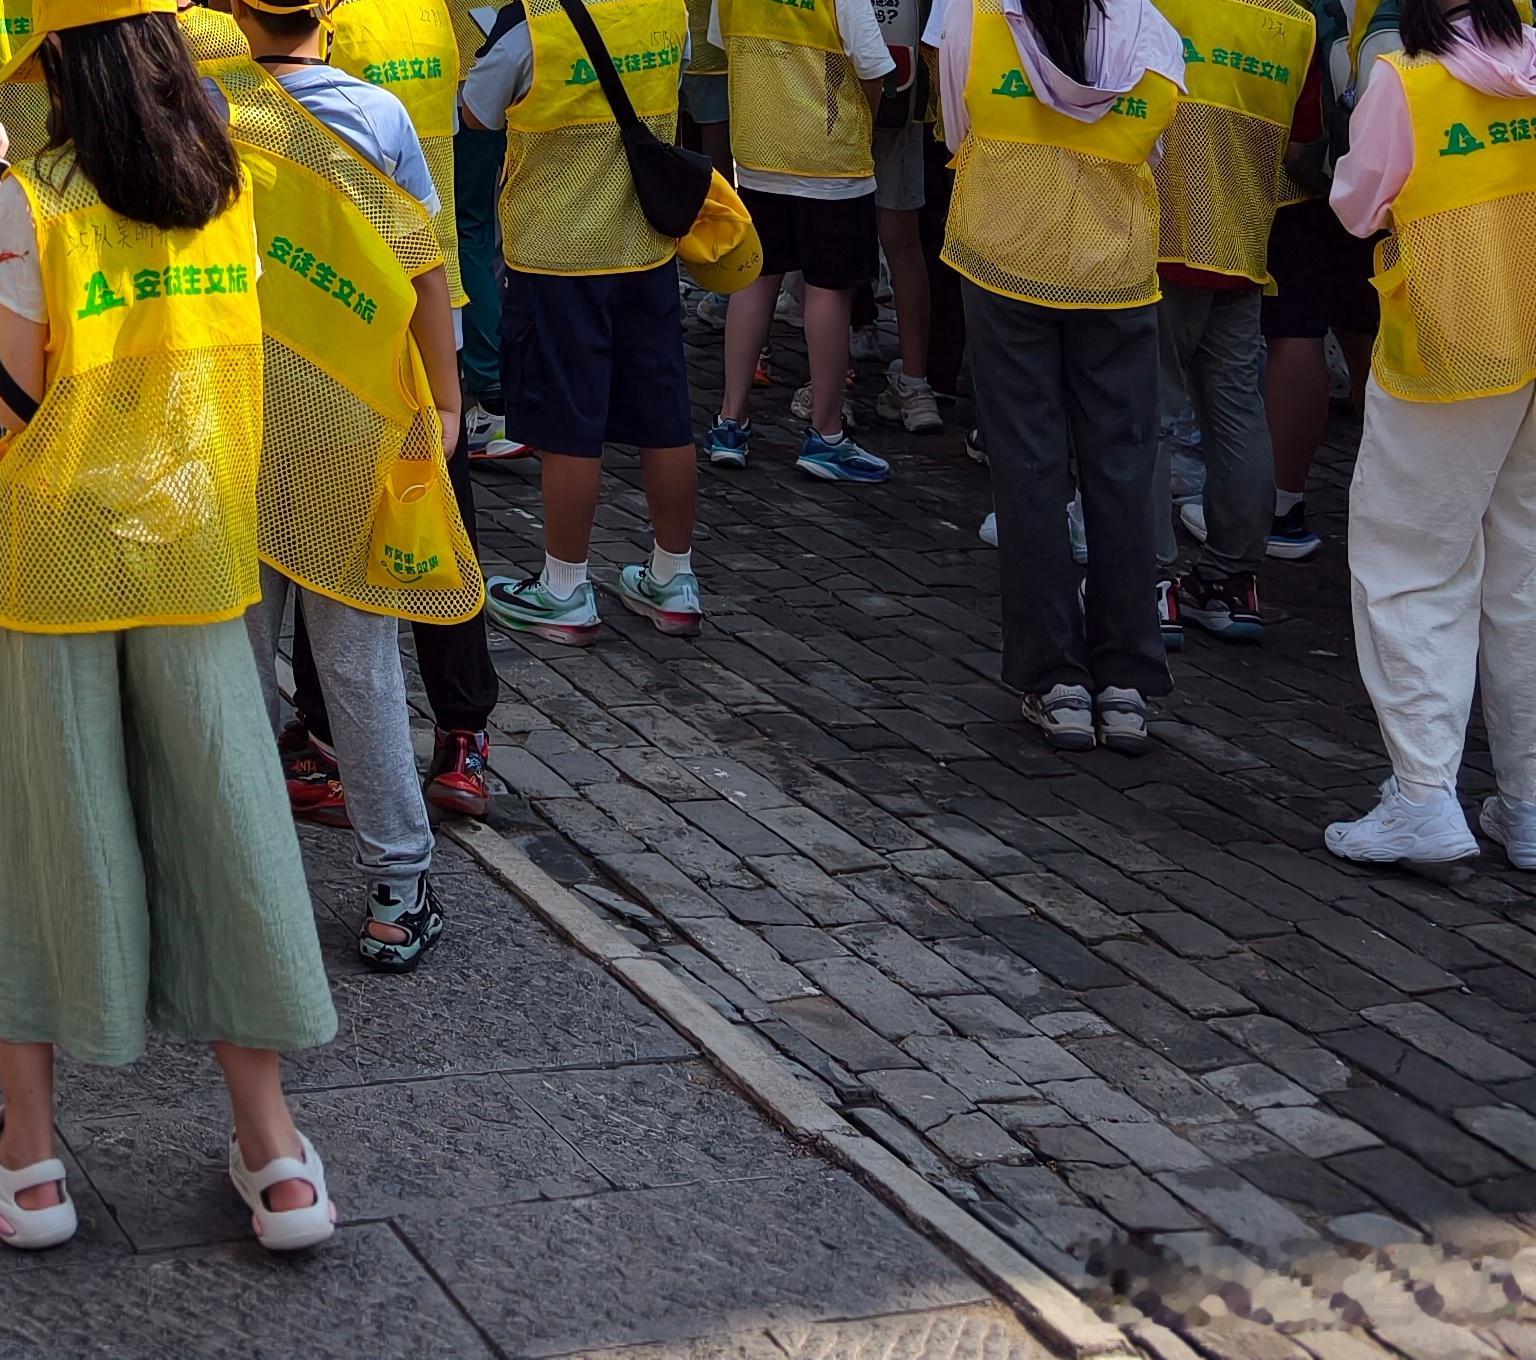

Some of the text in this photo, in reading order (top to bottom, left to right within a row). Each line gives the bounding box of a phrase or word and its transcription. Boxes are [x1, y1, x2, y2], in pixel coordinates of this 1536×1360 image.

[363, 56, 442, 84] 安徒生文旅
[1211, 47, 1290, 84] 安徒生文旅
[133, 263, 247, 301] 安徒生文旅
[267, 236, 378, 324] 安徒生文旅
